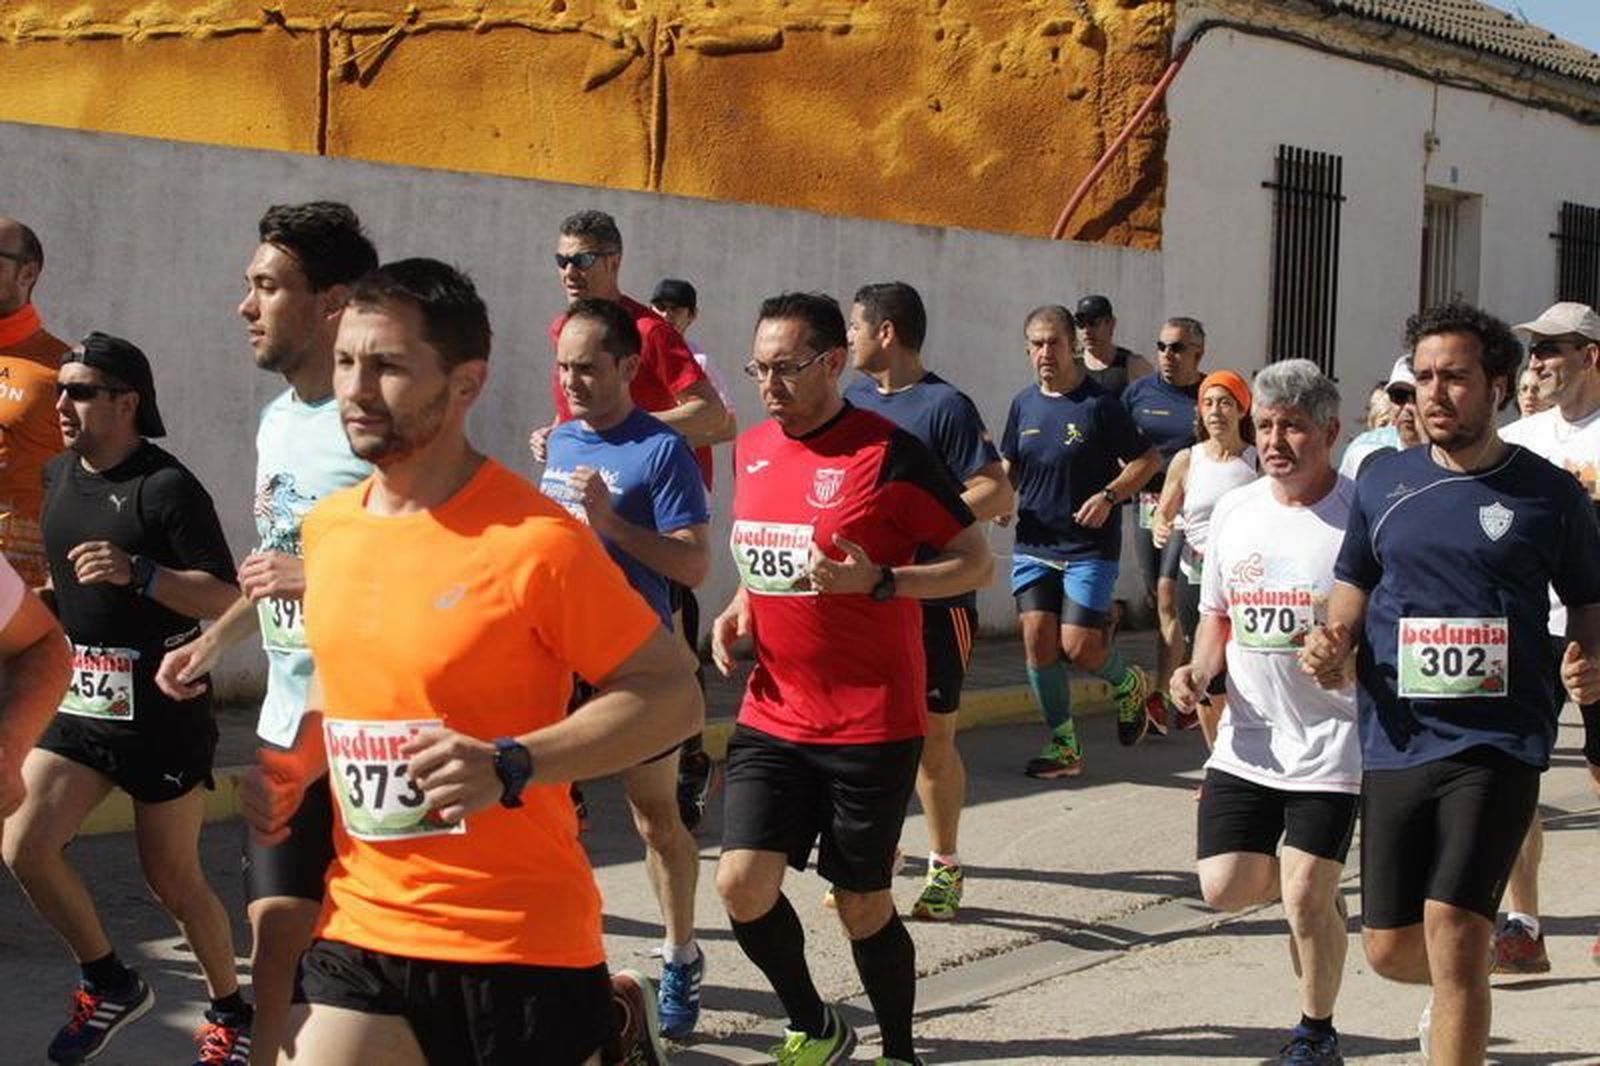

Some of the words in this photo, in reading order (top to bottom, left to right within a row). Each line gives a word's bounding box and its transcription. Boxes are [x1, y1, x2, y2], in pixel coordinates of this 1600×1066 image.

[734, 525, 808, 549] bedunia
[746, 548, 794, 578] 285
[1229, 587, 1311, 606] bedunia
[270, 598, 304, 629] 39
[1243, 607, 1295, 633] 370
[1402, 623, 1505, 645] bedunia
[1420, 647, 1486, 677] 302
[345, 763, 425, 809] 373
